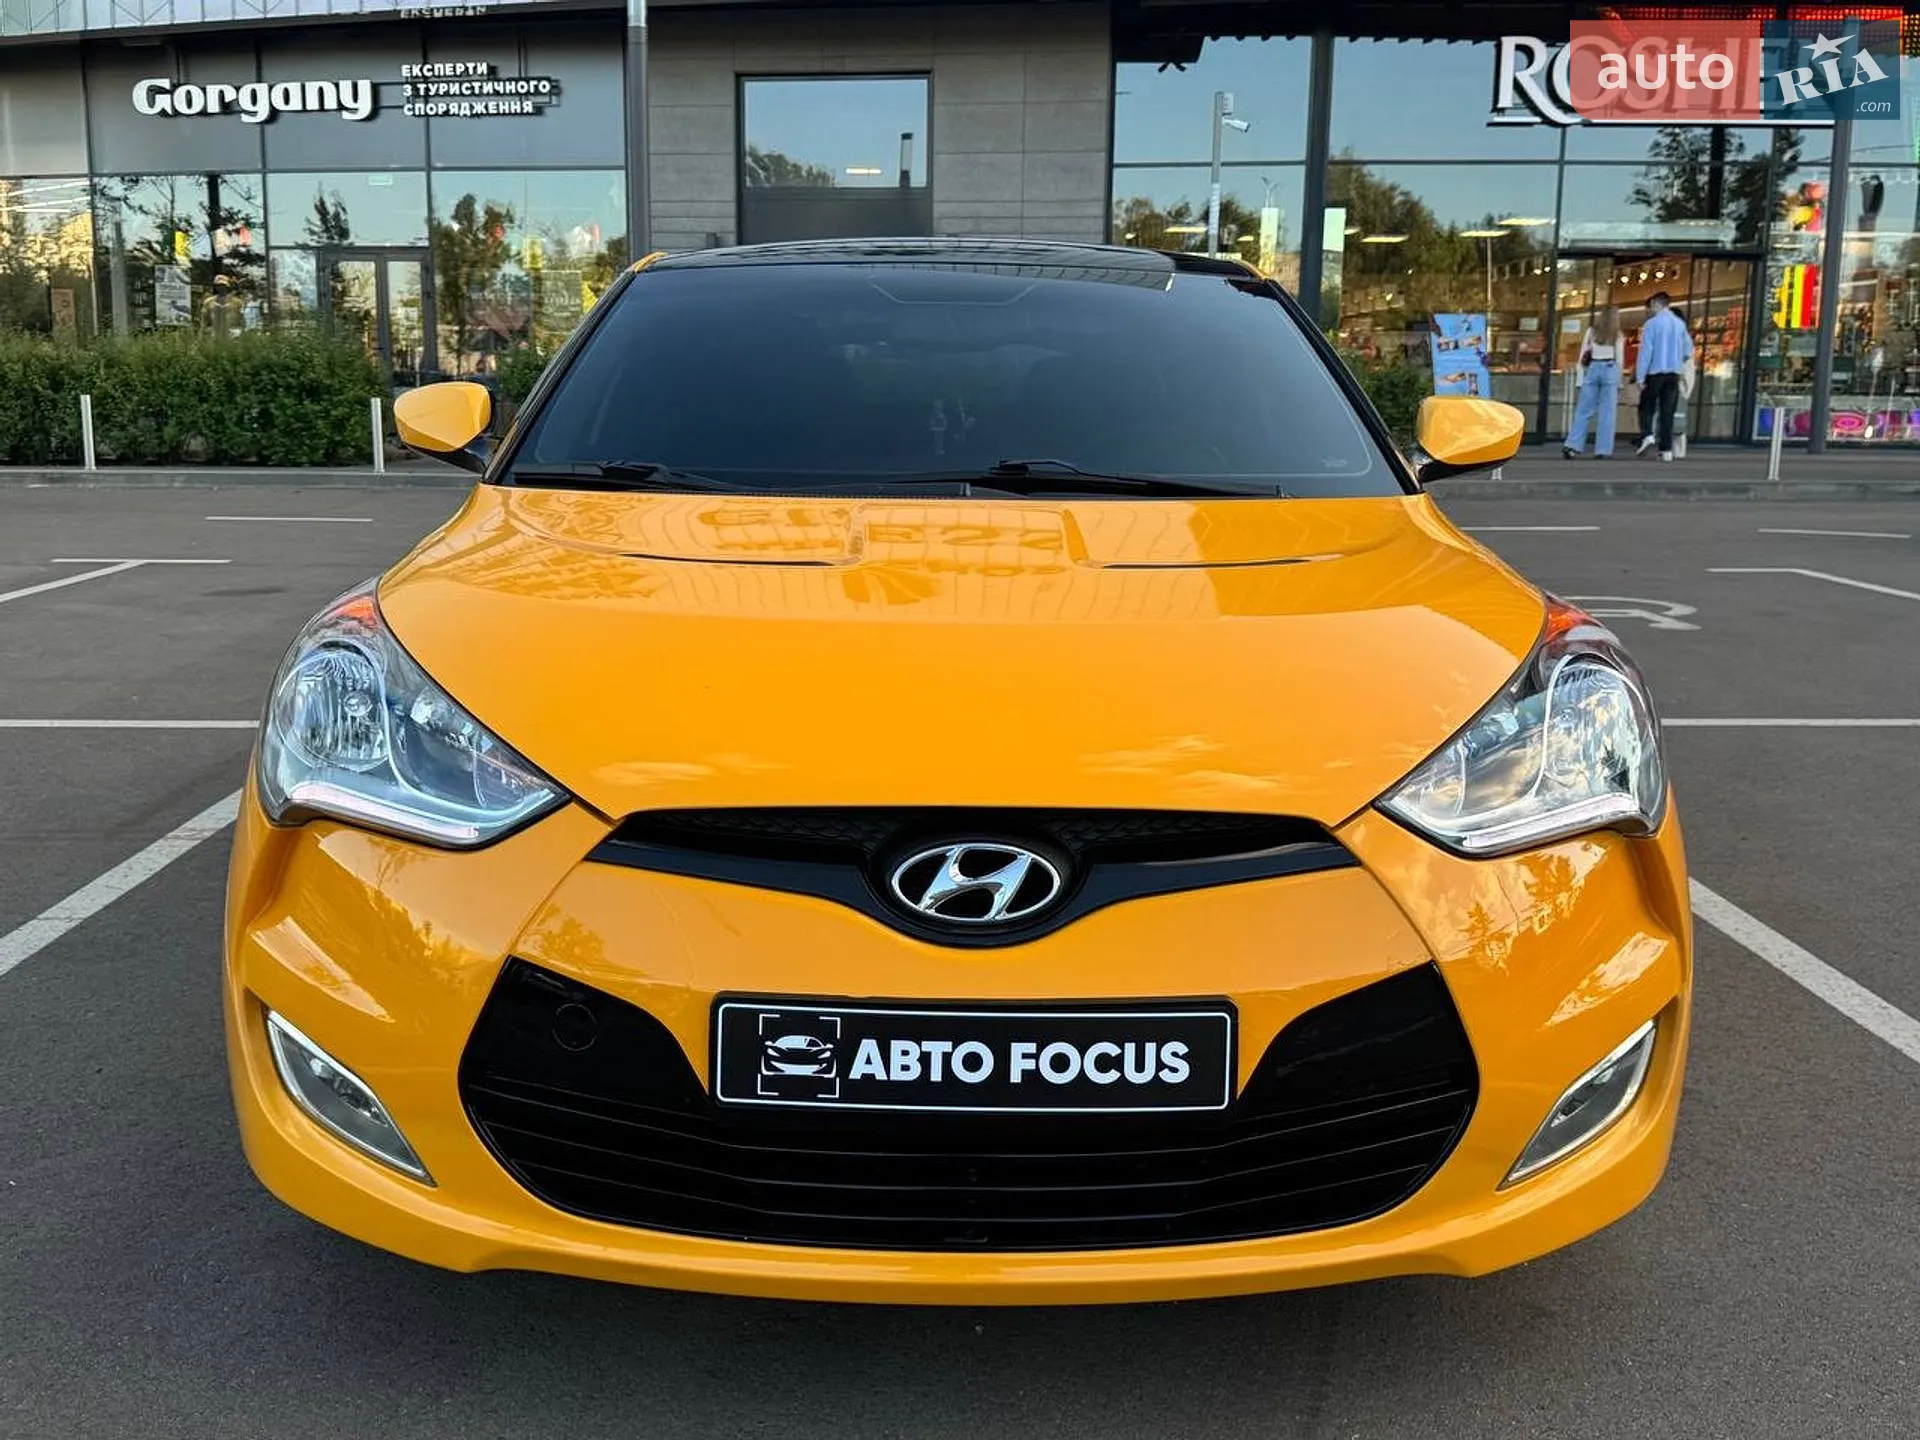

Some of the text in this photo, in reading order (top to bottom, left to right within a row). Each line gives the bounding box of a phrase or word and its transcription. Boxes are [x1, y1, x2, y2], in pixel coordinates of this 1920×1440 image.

[401, 62, 488, 77] ЕКСПЕРТИ
[417, 80, 551, 96] ТУРИСТИЧНОГО
[132, 78, 371, 123] Gorgany
[403, 101, 534, 117] СПОРЯДЖЕННЯ
[1009, 1041, 1191, 1085] FOCUS
